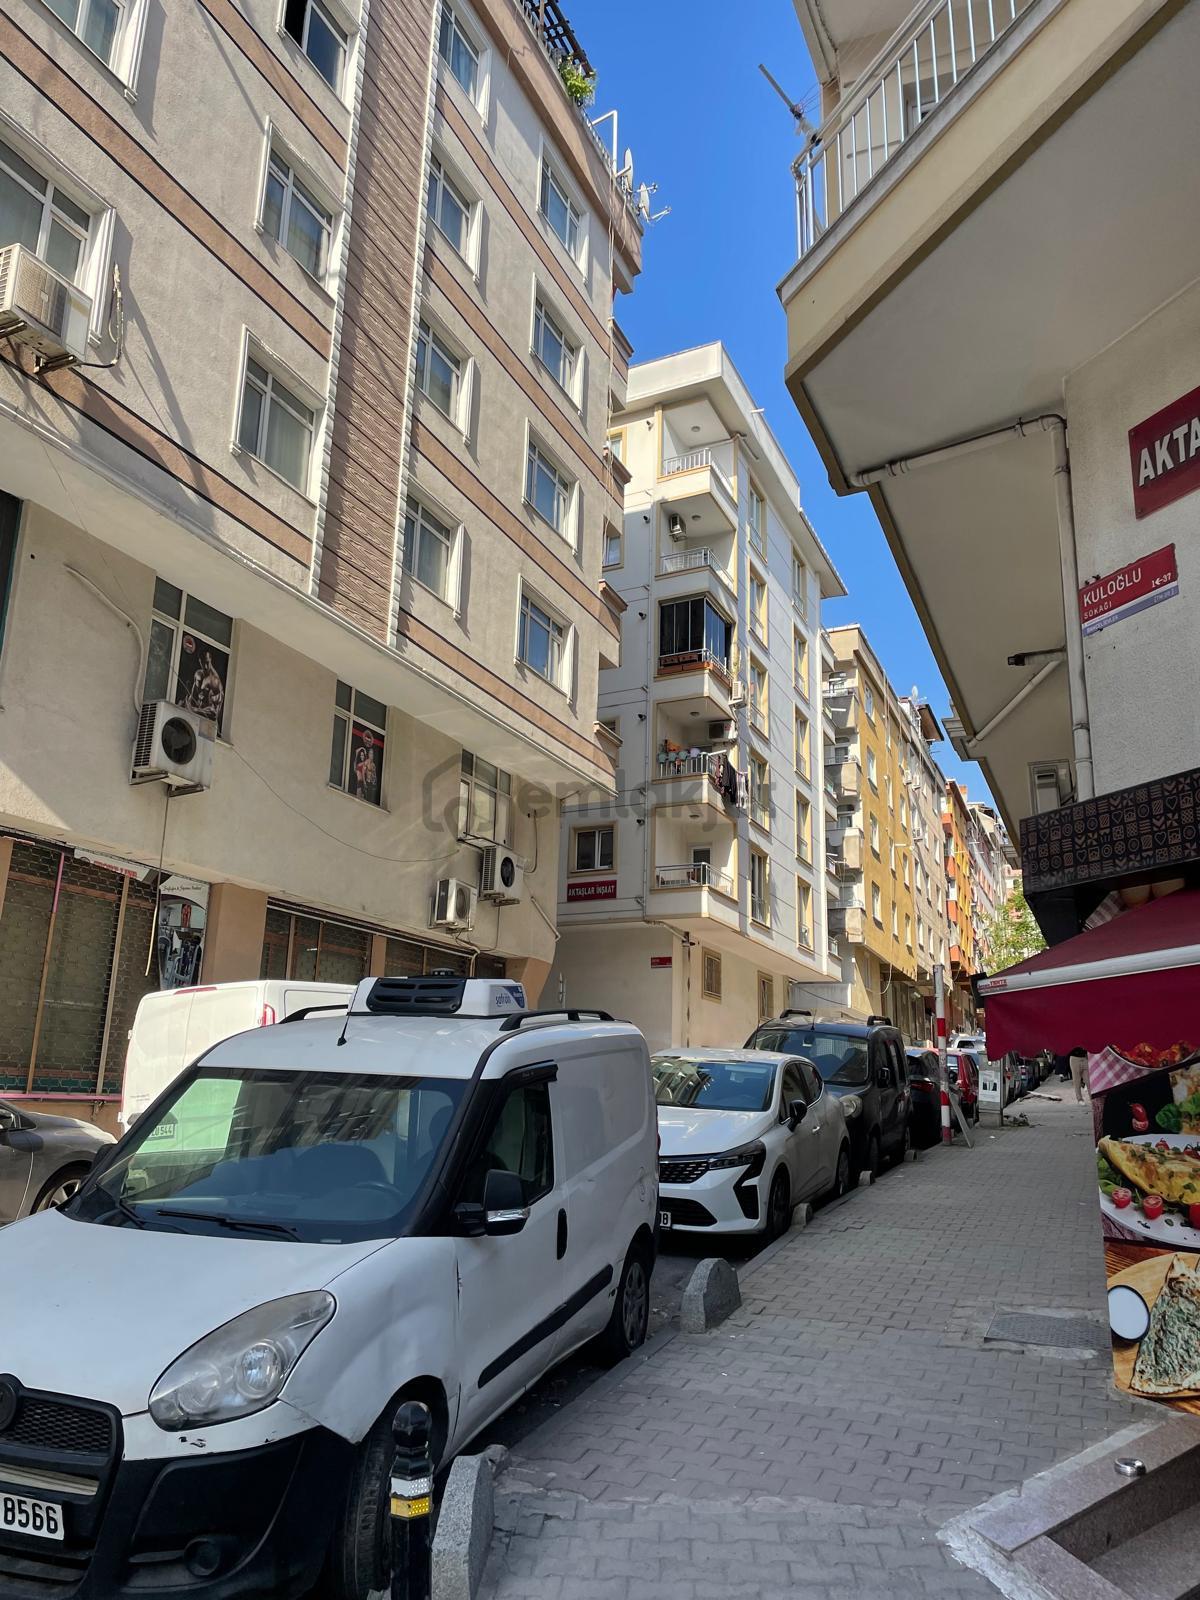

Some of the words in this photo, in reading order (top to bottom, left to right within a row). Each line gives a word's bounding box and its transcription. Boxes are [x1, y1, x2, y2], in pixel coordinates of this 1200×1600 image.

[1083, 567, 1142, 607] KULOĞLU
[1084, 601, 1112, 620] SOKAĞI
[568, 887, 595, 897] AKTAŞLAR
[3, 1497, 59, 1534] 8566
